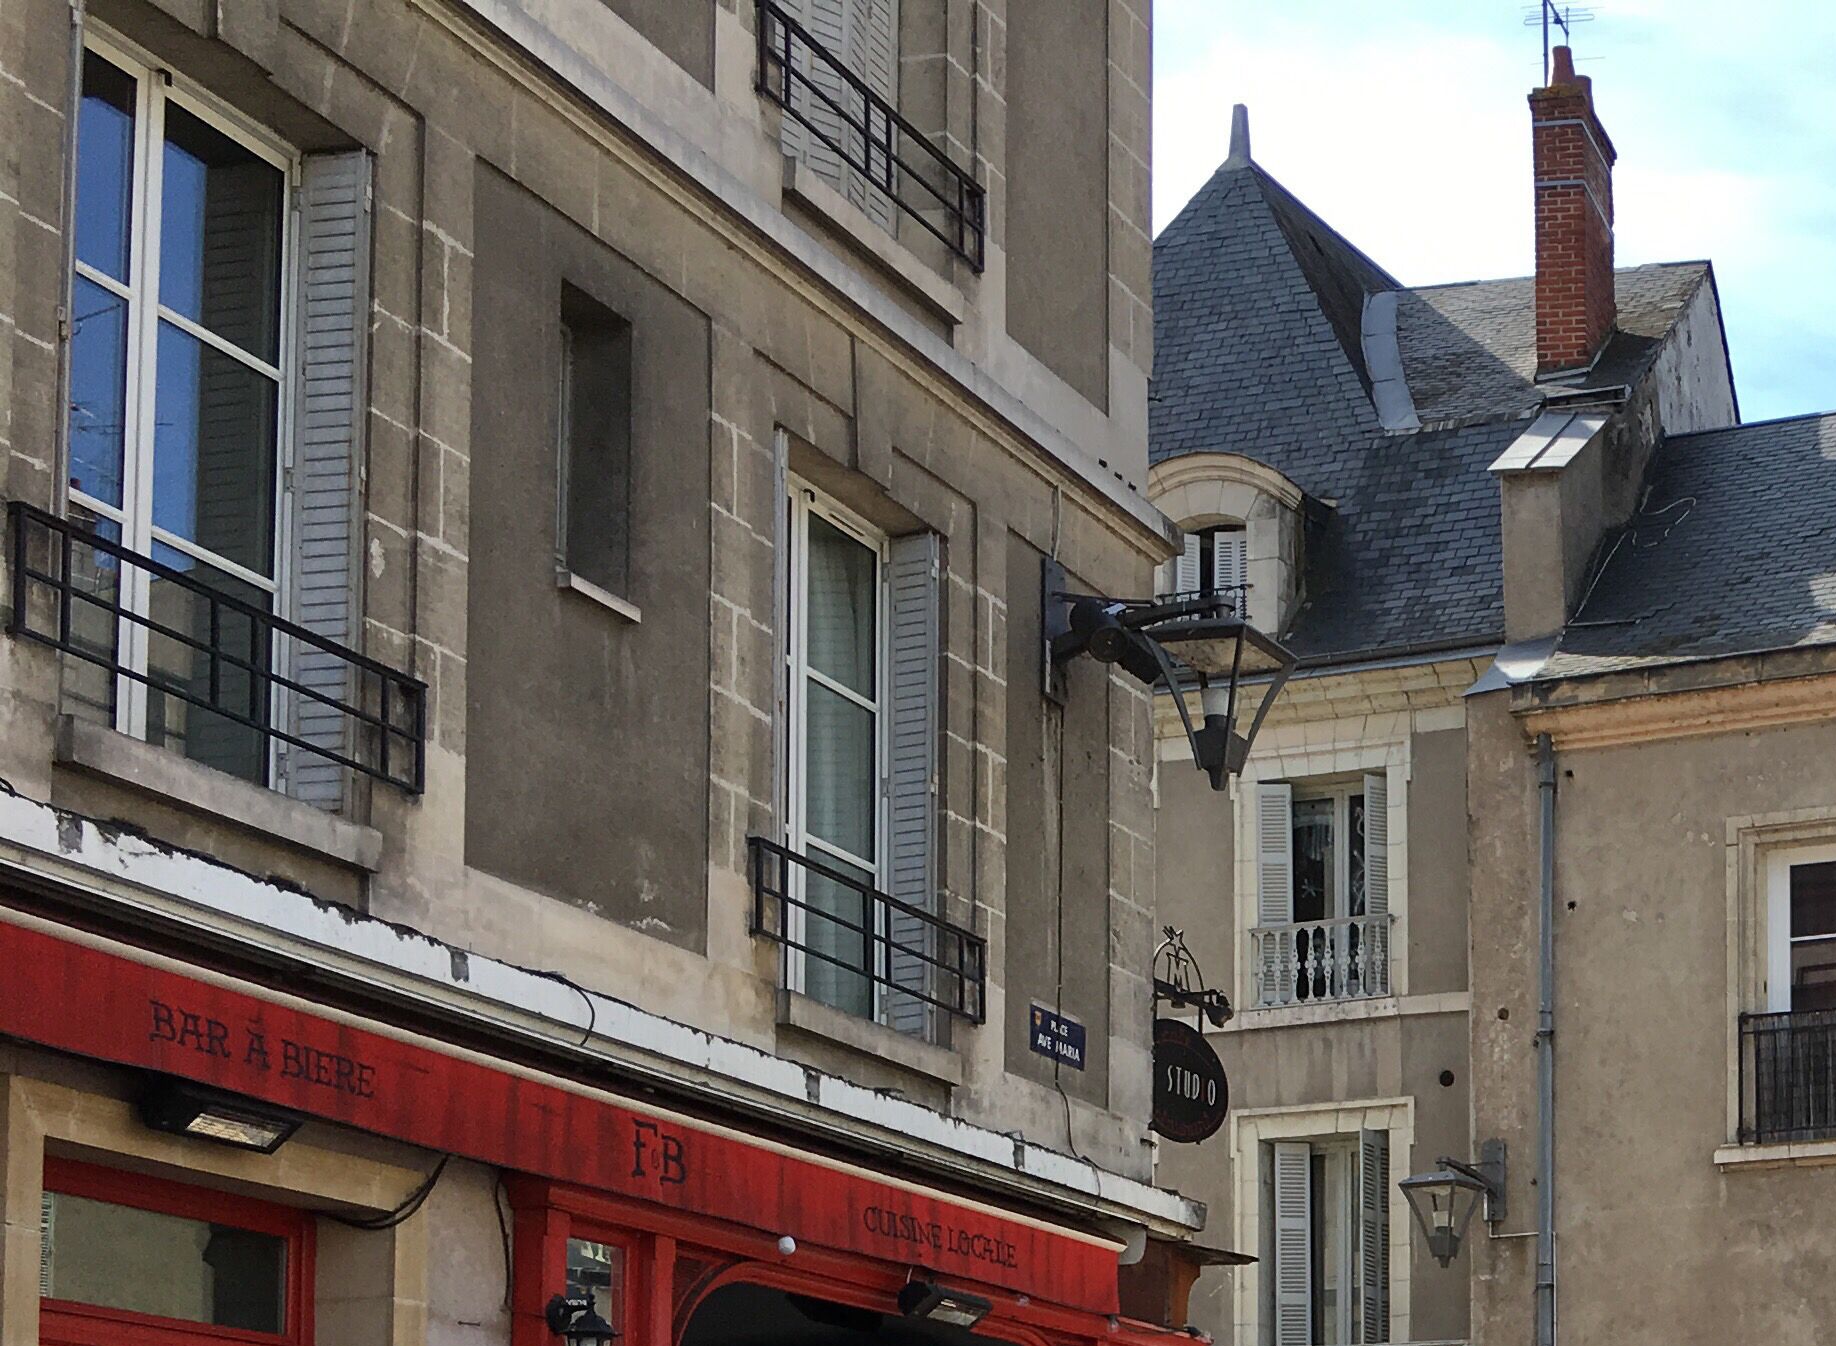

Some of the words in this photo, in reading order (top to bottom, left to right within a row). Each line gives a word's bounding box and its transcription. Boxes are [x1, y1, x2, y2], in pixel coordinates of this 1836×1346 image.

[1037, 1033, 1051, 1050] AVE
[1050, 1020, 1068, 1037] PLCE
[149, 1001, 231, 1058] BAR
[280, 1039, 376, 1098] BIERE
[1167, 1065, 1216, 1106] STUDIO
[863, 1206, 942, 1249] CUISINE
[948, 1226, 1018, 1269] LOCALE
